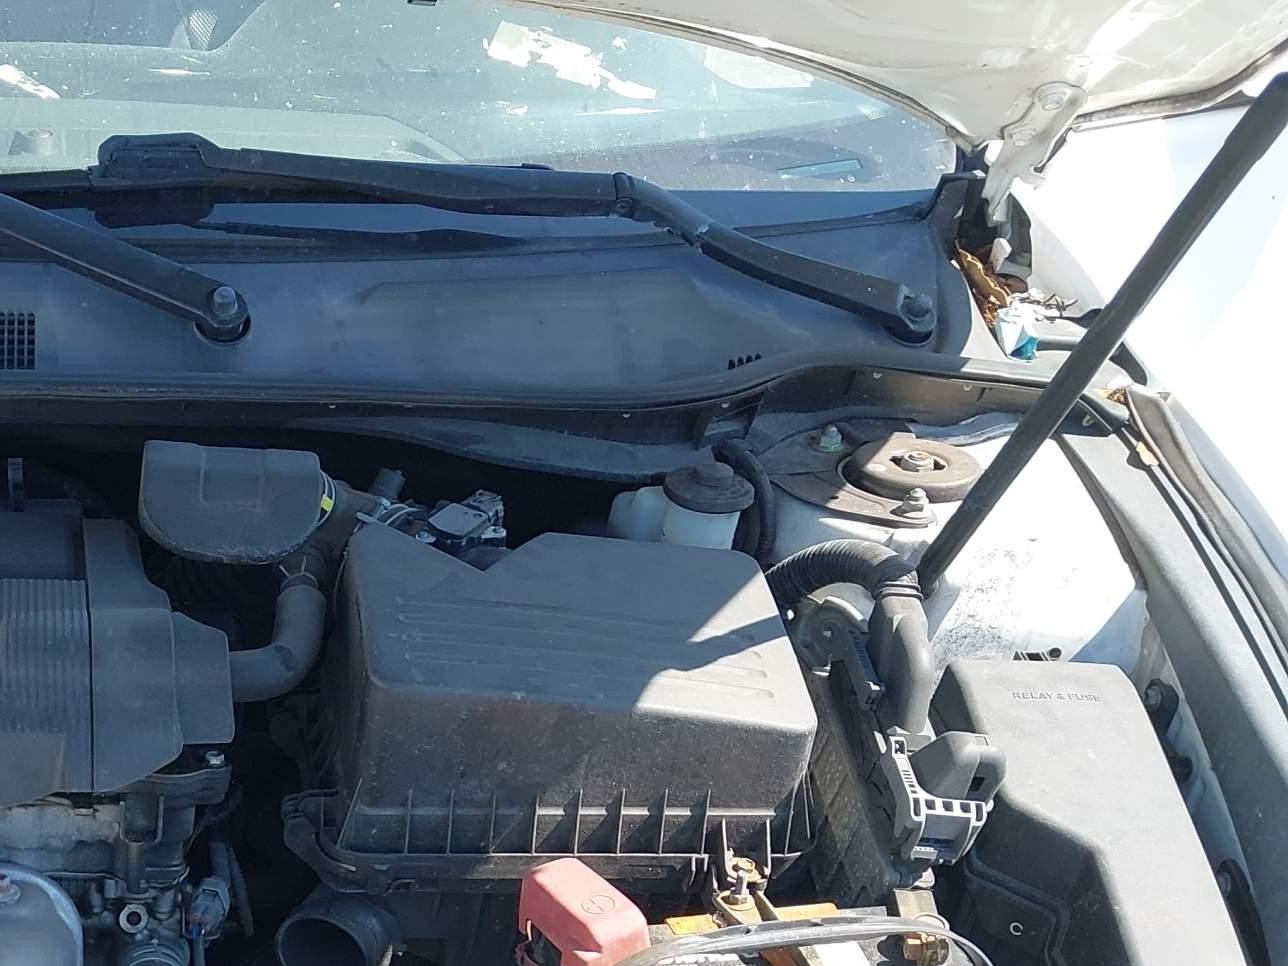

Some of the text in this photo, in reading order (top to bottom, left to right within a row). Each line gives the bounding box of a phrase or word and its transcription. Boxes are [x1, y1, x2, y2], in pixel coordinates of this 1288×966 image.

[1011, 691, 1102, 702] RELAY & FUSE
